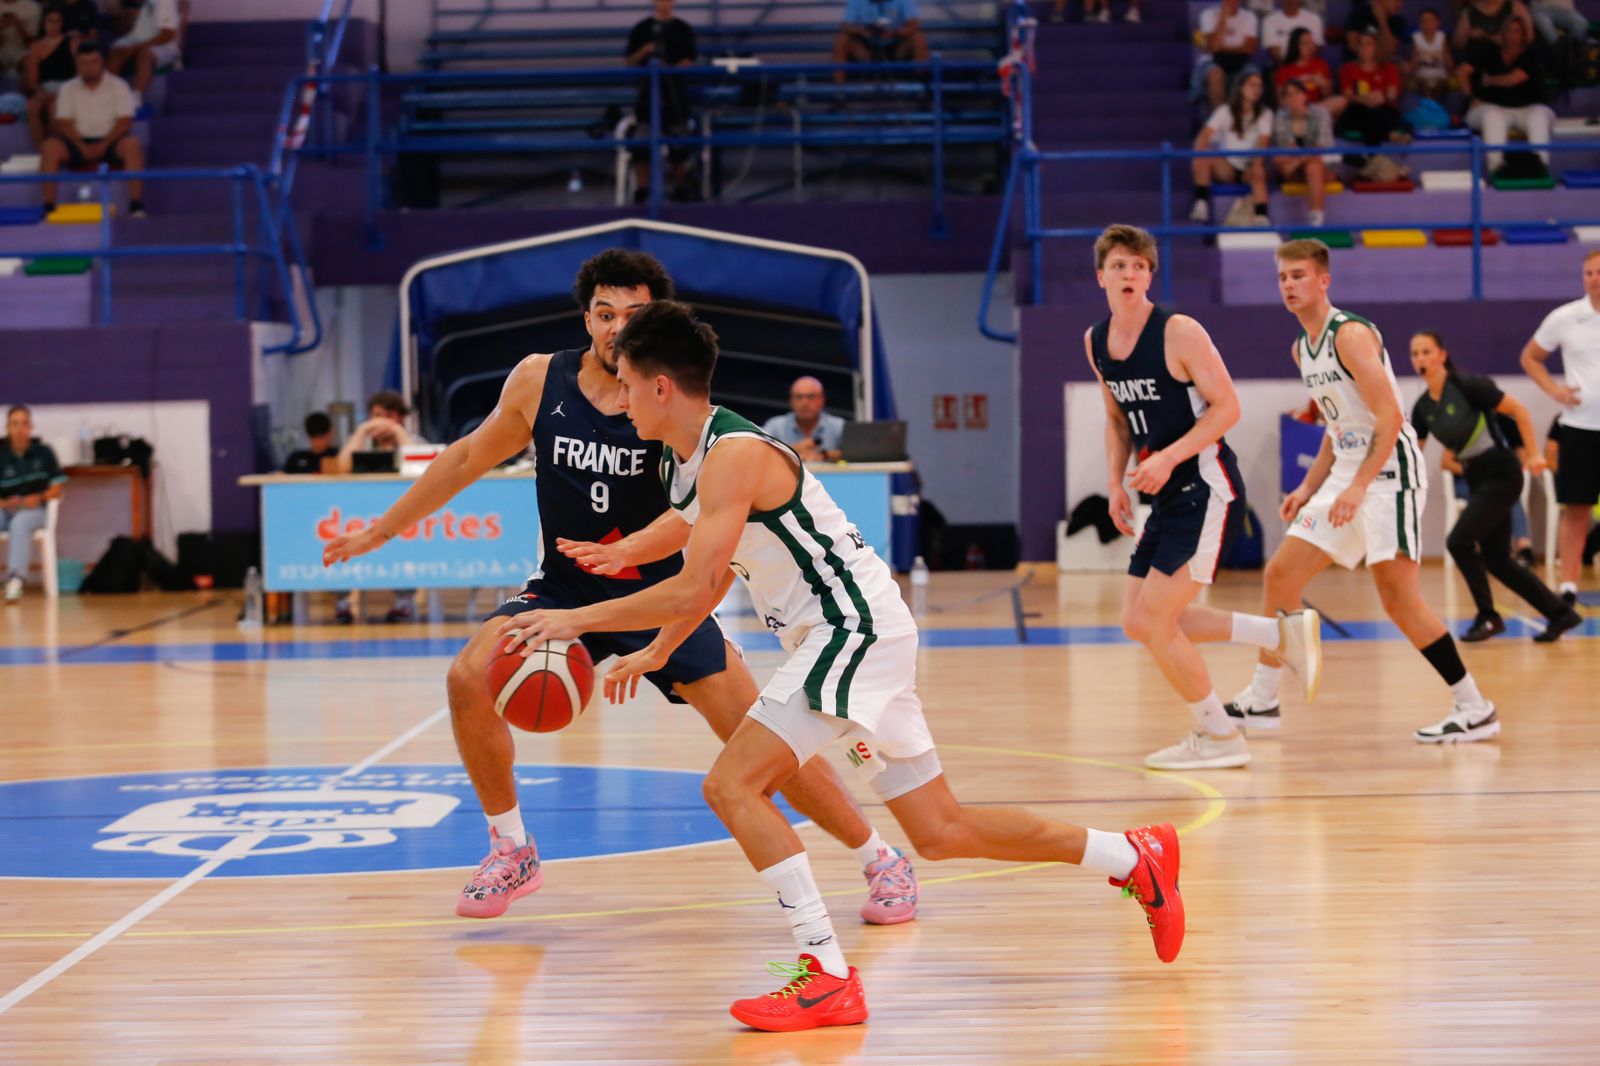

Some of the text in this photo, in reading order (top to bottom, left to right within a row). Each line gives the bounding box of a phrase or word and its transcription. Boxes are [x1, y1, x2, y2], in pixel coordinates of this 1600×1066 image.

[1305, 370, 1342, 388] ETUVA
[1127, 409, 1149, 435] 11
[553, 435, 647, 476] FRANCE
[590, 480, 610, 513] 9
[316, 507, 503, 541] deortes
